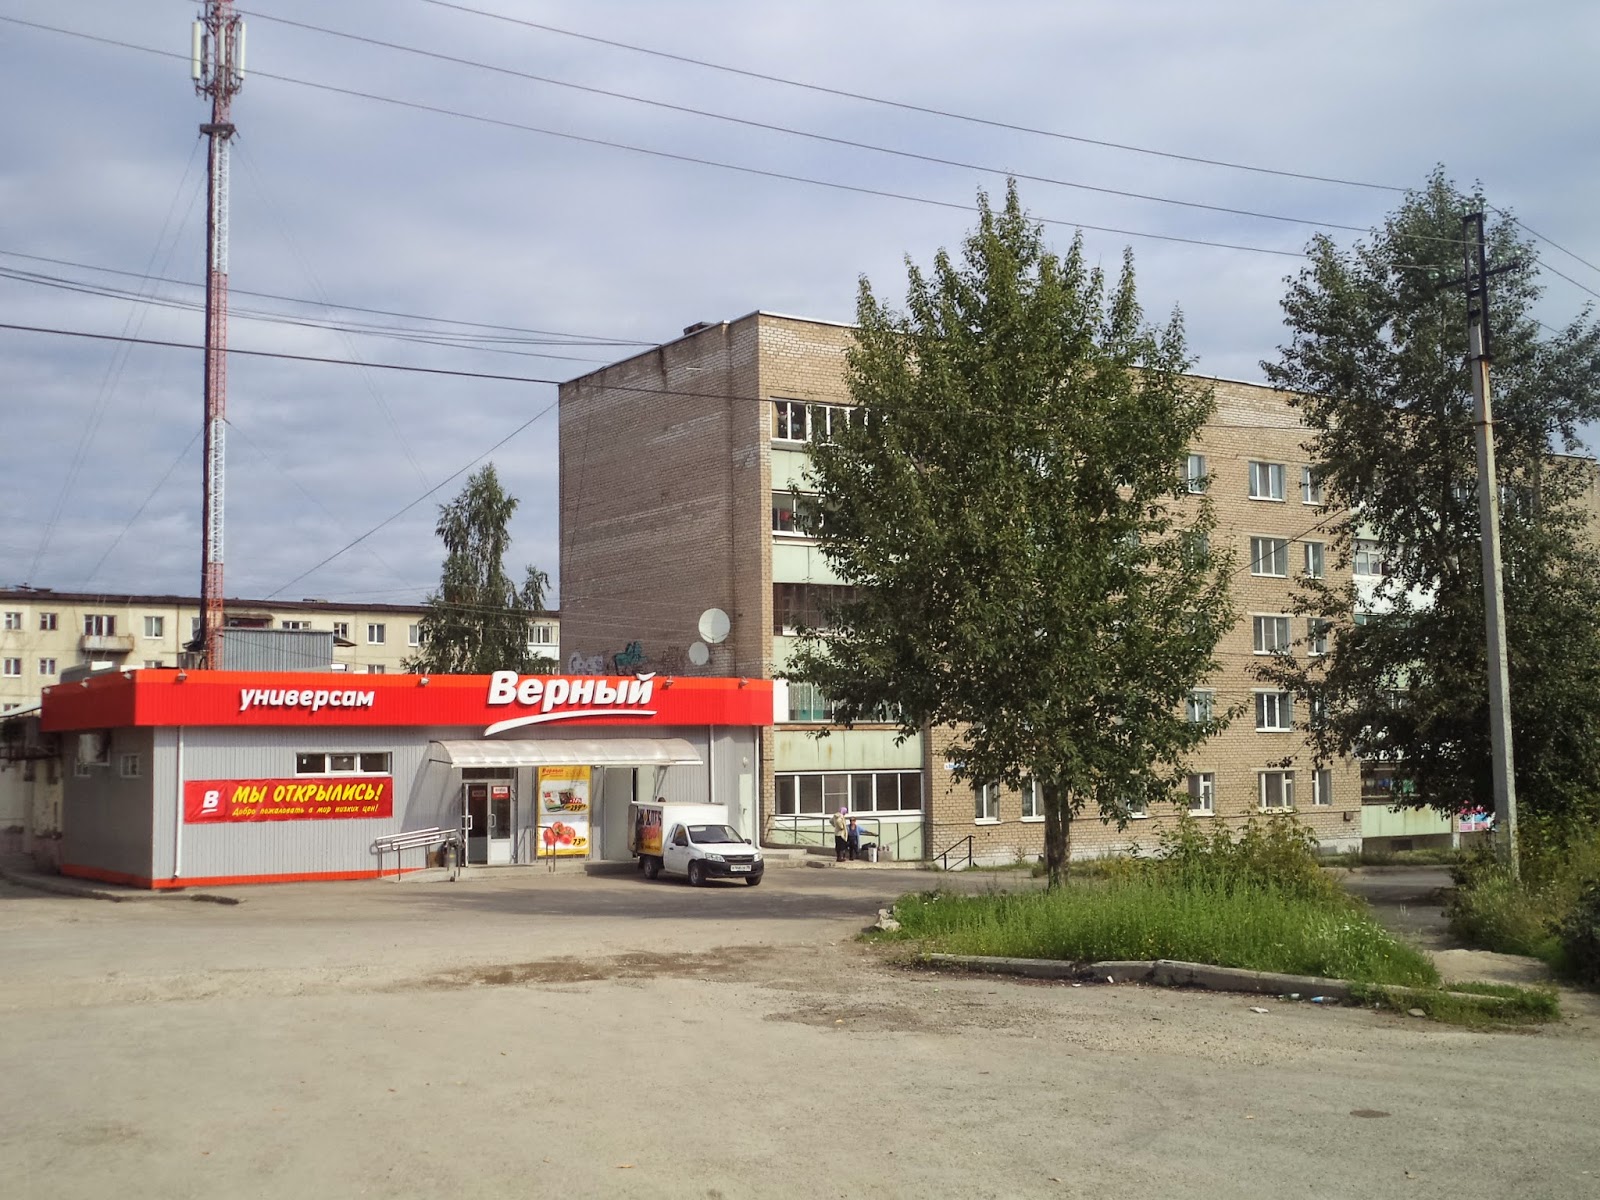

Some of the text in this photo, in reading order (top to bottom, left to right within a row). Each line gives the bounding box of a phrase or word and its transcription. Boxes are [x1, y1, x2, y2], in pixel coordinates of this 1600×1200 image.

[240, 688, 375, 711] универсам
[488, 670, 657, 712] Верный
[232, 783, 384, 804] МЫ ОТКРЫЛИСЬ!
[232, 807, 256, 817] Добро
[260, 806, 304, 815] пожаловать
[317, 806, 331, 815] мир
[335, 804, 358, 813] низких
[362, 804, 379, 813] цен!
